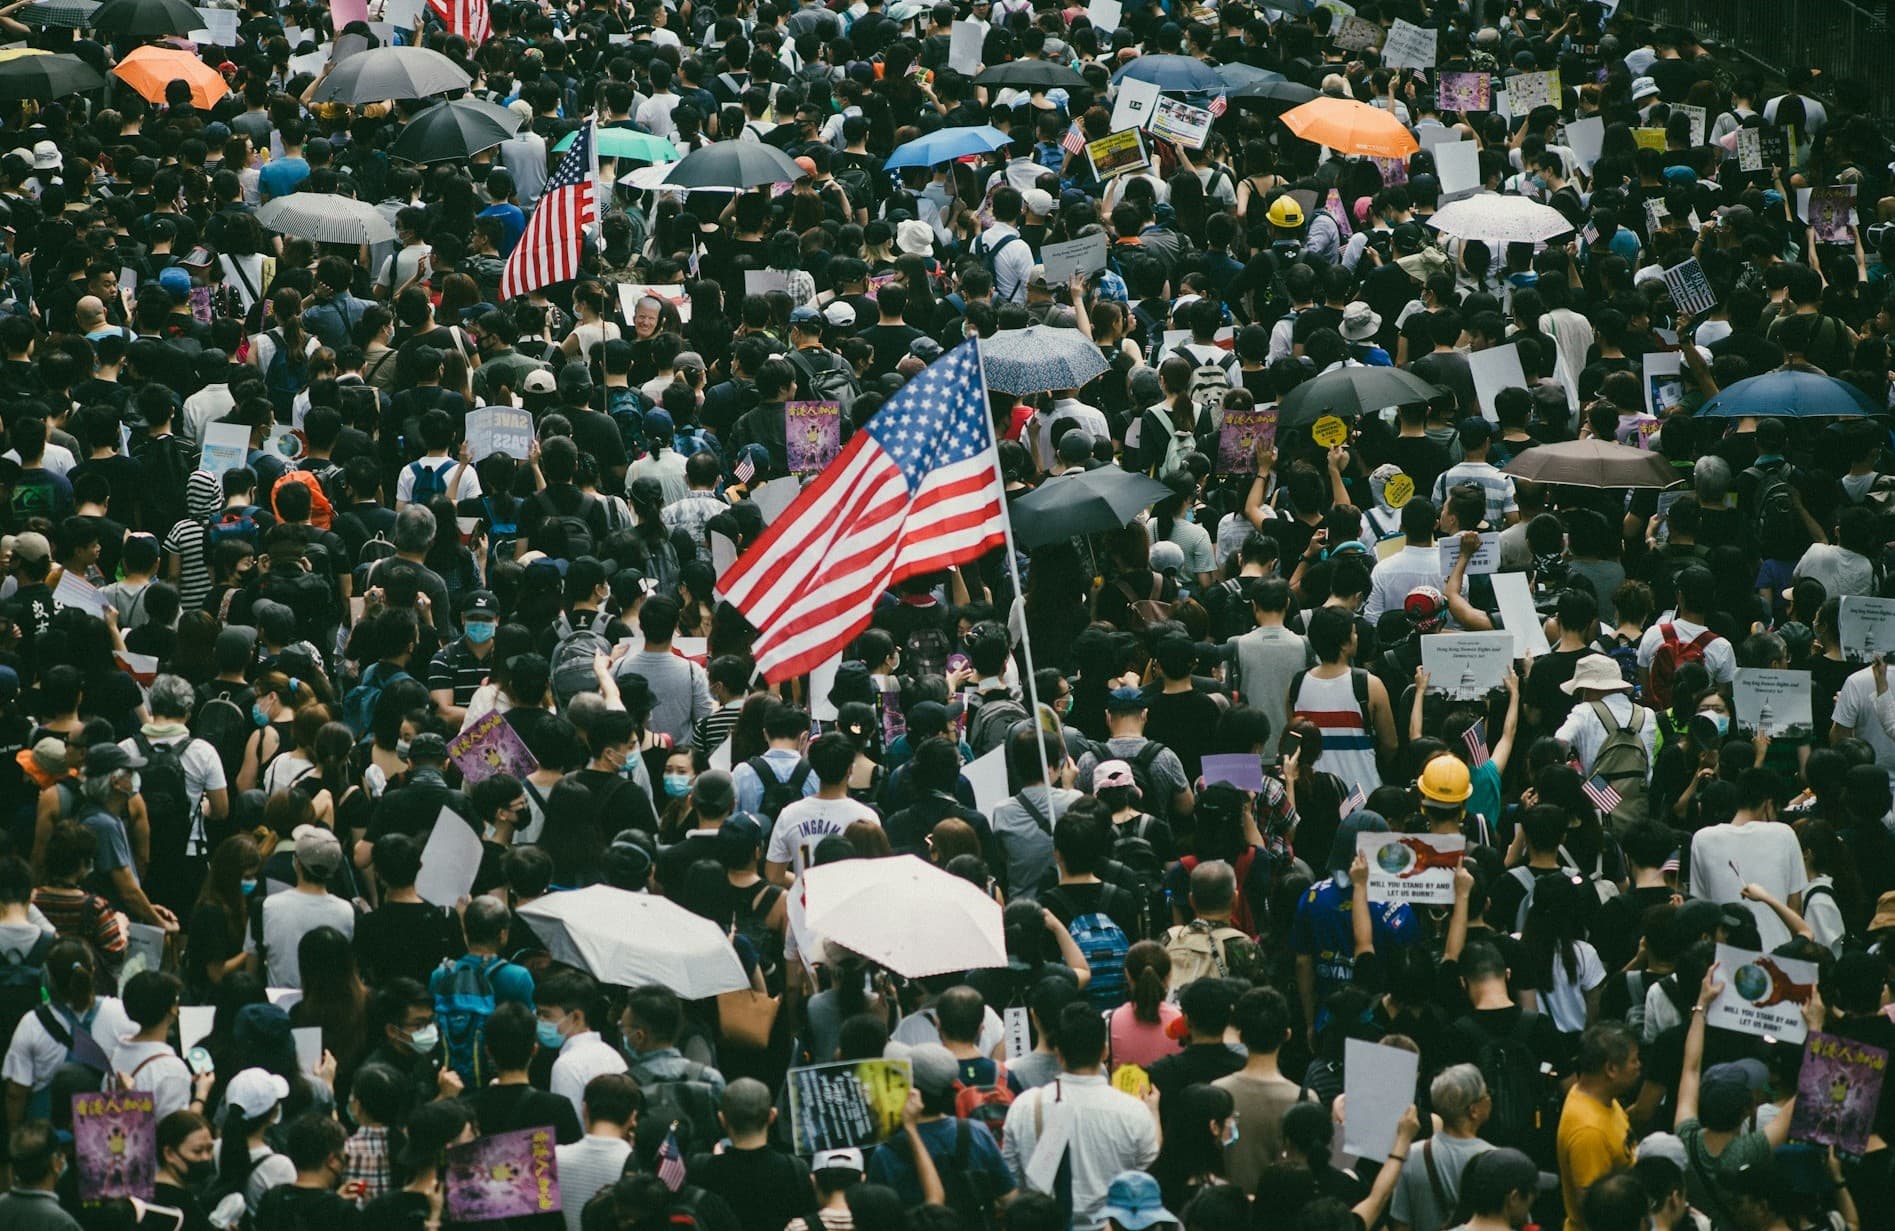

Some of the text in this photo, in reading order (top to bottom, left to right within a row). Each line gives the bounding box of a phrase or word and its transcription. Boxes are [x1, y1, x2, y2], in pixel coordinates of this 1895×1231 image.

[1691, 272, 1711, 297] PASS
[451, 714, 502, 757] 香港人加油
[798, 819, 842, 838] INGRAM
[1387, 889, 1400, 897] LET
[1411, 890, 1435, 898] BURN?
[1402, 881, 1424, 889] STAND
[1723, 1005, 1798, 1027] WILL YOU STAND BY AND
[1739, 1018, 1782, 1032] LET US BURN?
[77, 1098, 153, 1117] 香港人加油
